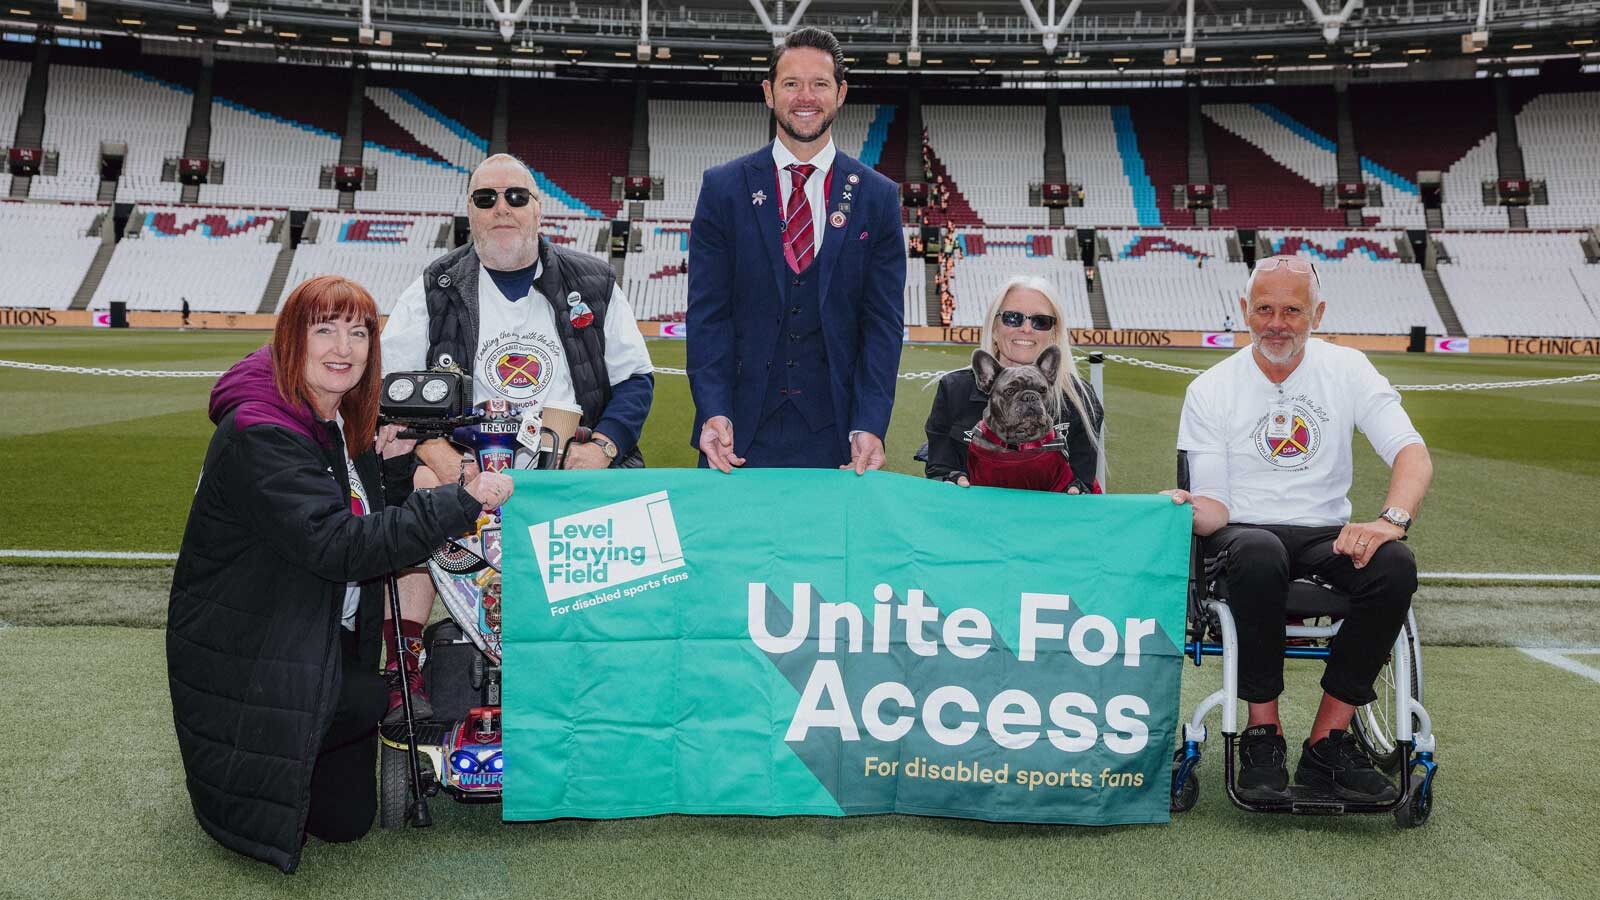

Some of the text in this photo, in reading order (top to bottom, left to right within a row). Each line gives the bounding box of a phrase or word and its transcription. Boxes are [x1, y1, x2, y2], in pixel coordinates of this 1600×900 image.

[0, 310, 57, 326] TIONS
[1083, 330, 1171, 346] SOLUTIONS
[481, 423, 517, 433] TREVOR
[549, 518, 613, 539] Level
[549, 540, 646, 566] Playing
[549, 563, 608, 584] Field
[550, 572, 689, 617] For disabled sports fans
[748, 582, 1156, 667] Unite For
[784, 659, 1150, 755] Access
[864, 756, 1144, 791] For disabled sports fans
